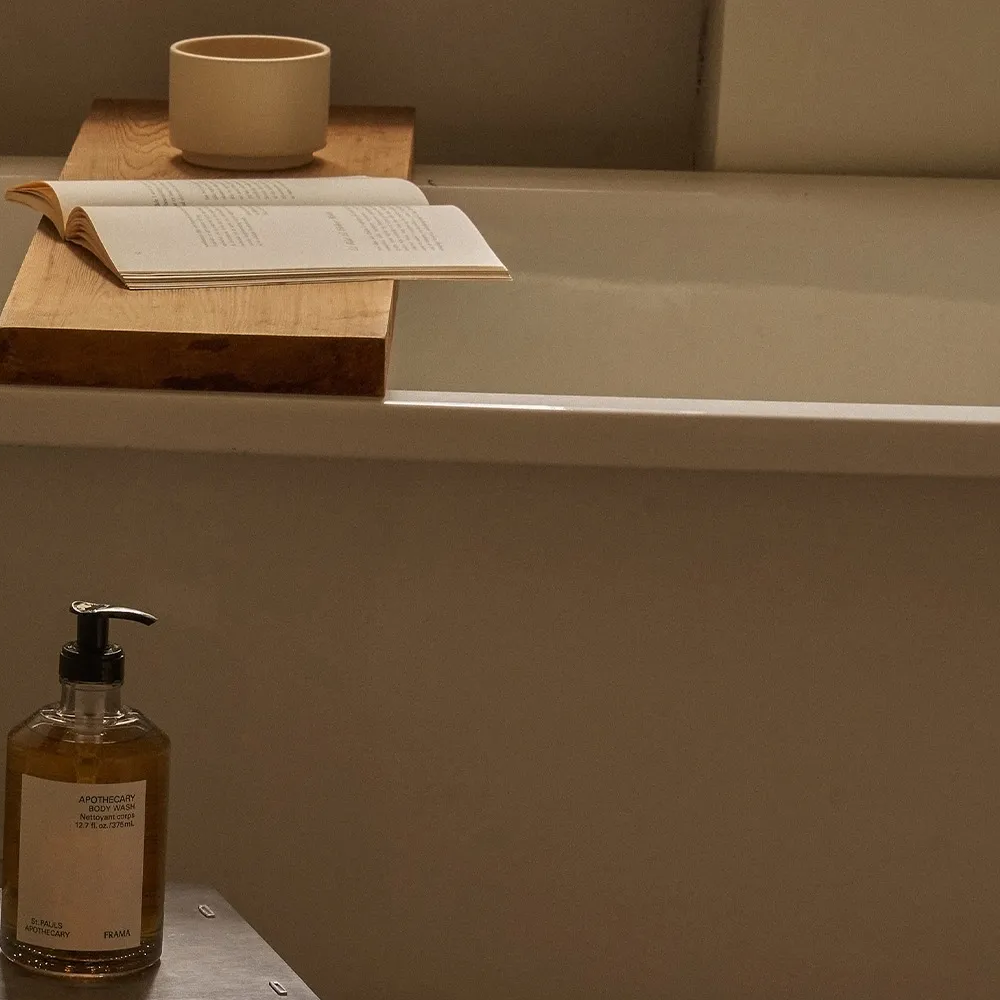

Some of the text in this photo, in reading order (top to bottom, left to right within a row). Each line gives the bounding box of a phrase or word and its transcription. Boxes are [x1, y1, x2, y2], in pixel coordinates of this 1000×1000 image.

[79, 794, 136, 804] APOTHECARY
[88, 803, 136, 813] BODY WASH
[80, 813, 115, 822] Nettoyant
[25, 924, 71, 939] APOTHECARY
[103, 929, 131, 939] FRAMA
